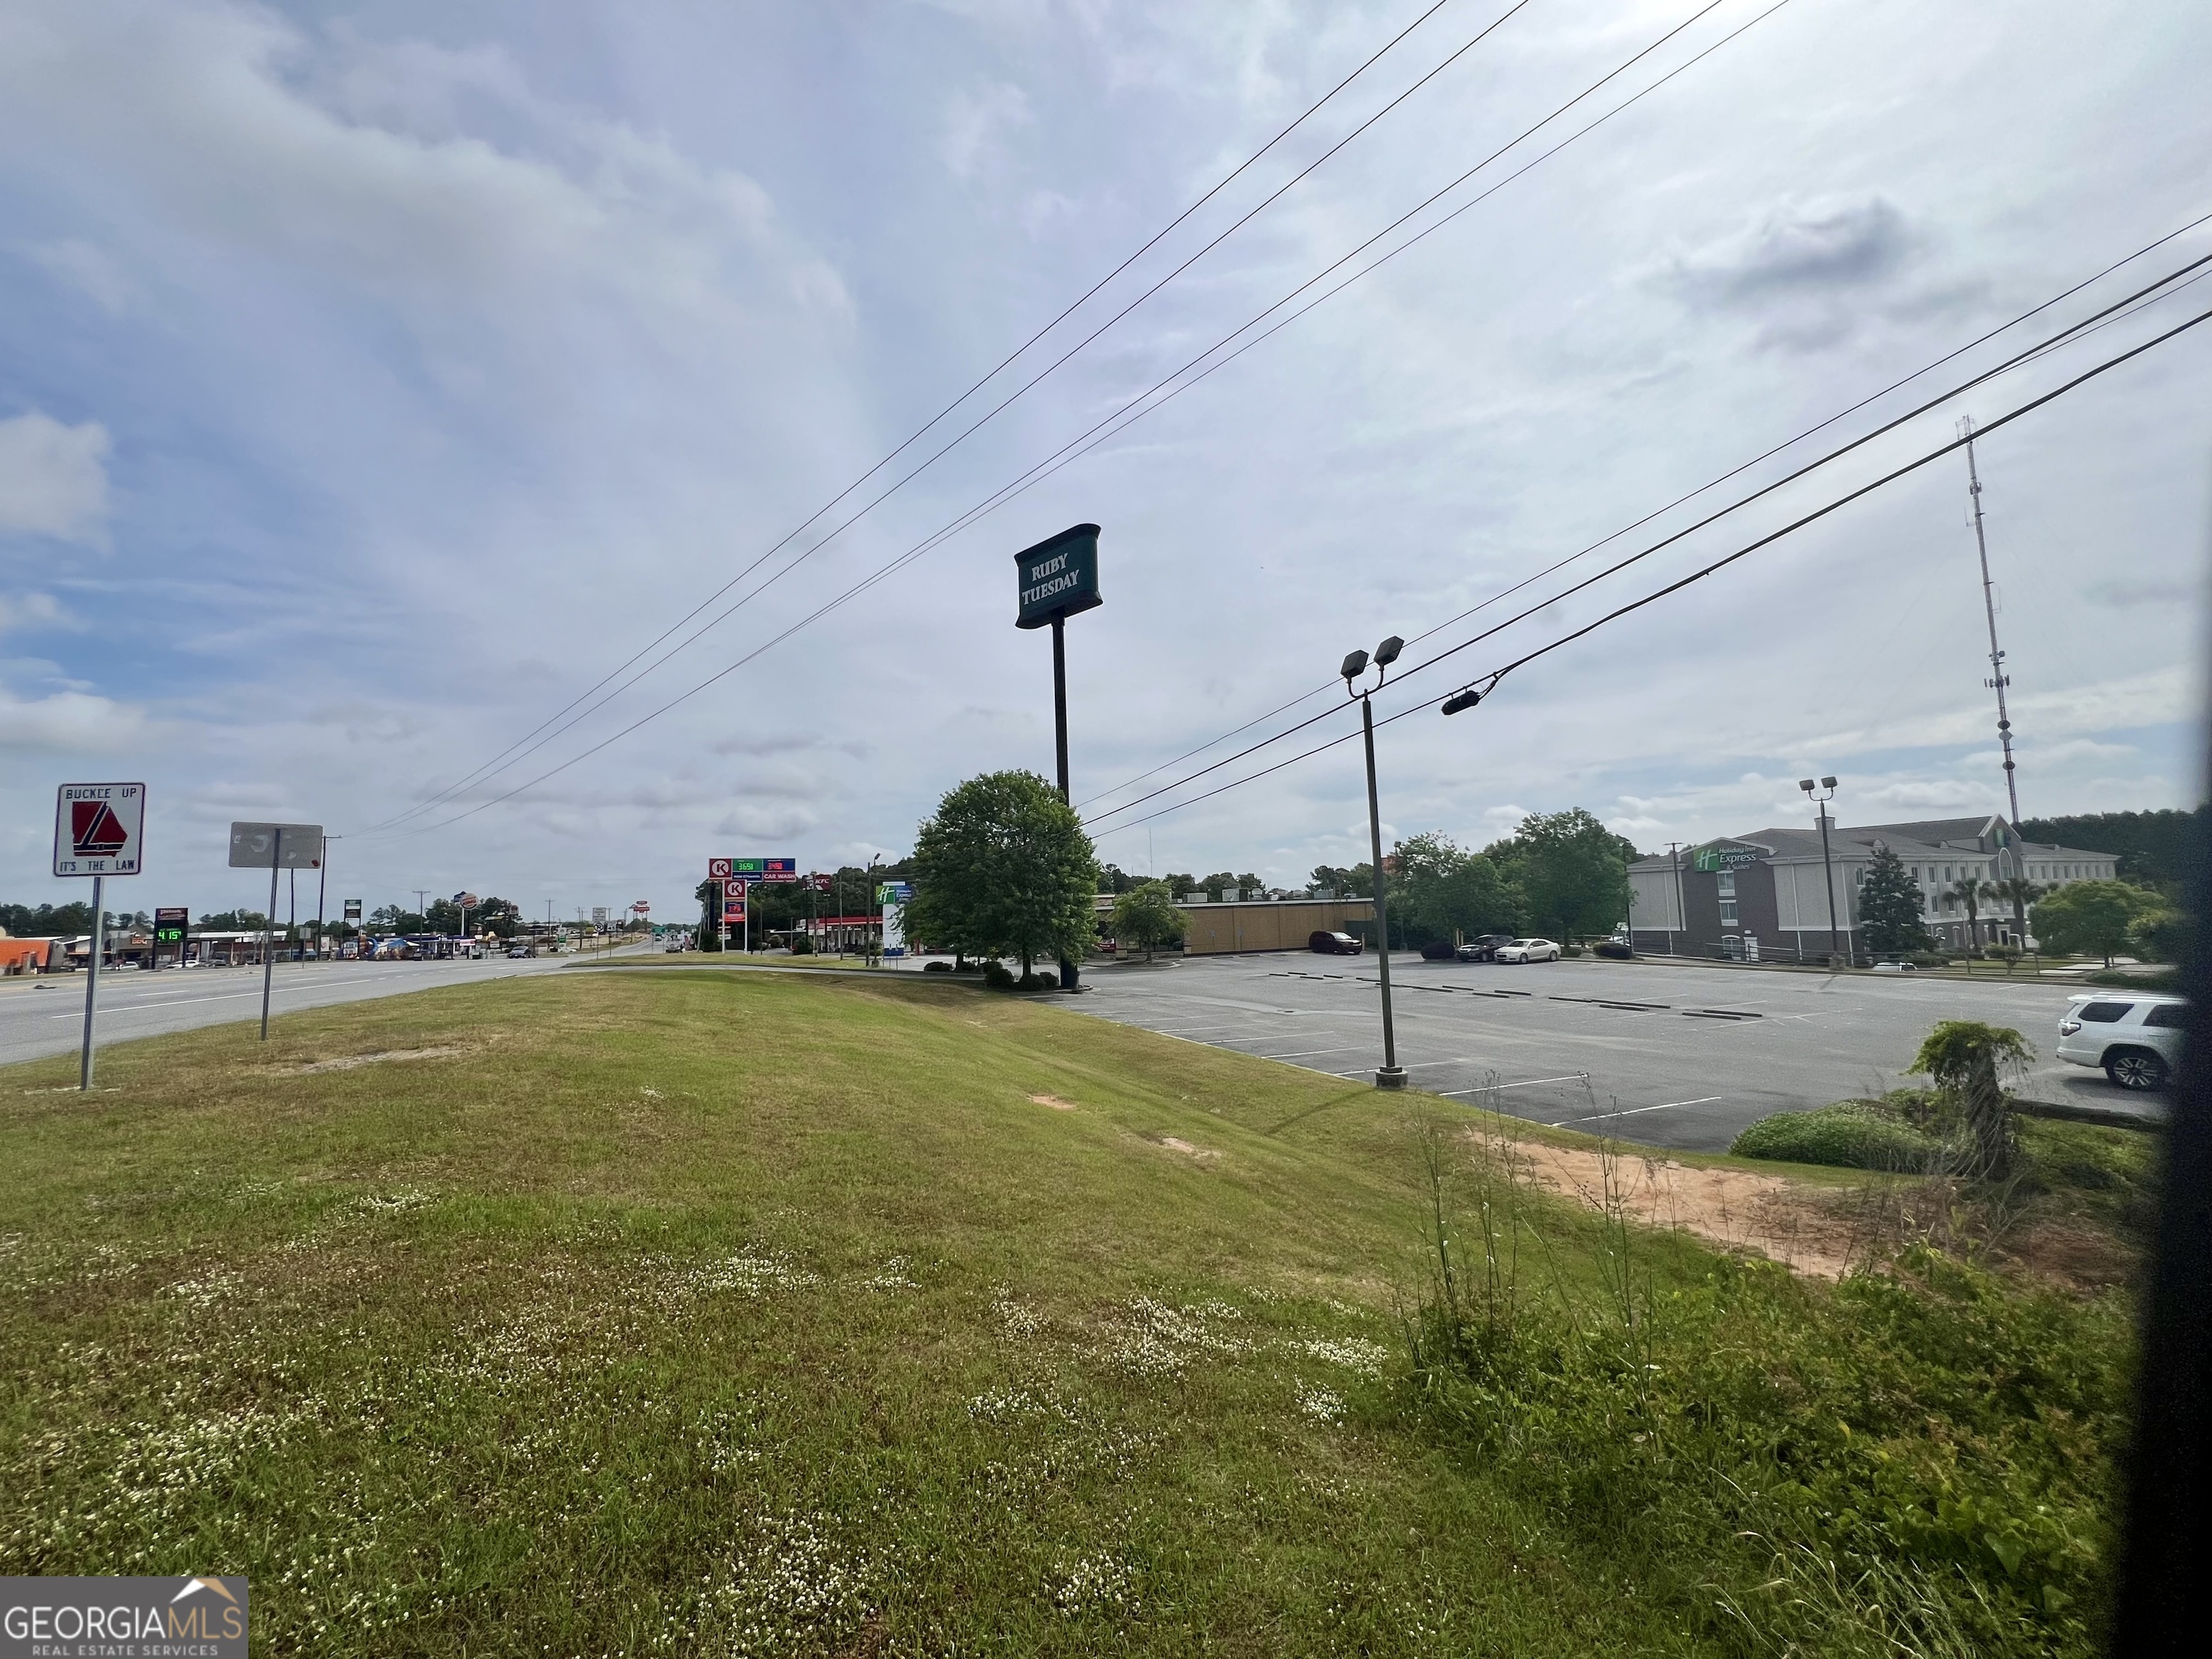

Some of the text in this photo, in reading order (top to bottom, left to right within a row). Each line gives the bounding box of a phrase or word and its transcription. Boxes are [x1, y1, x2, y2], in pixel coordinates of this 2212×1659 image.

[1031, 552, 1069, 582] RUBY
[1022, 569, 1079, 605] TUESDAY
[122, 788, 137, 798] UP
[1719, 854, 1757, 864] Express
[60, 860, 135, 872] IT'S THE LAW
